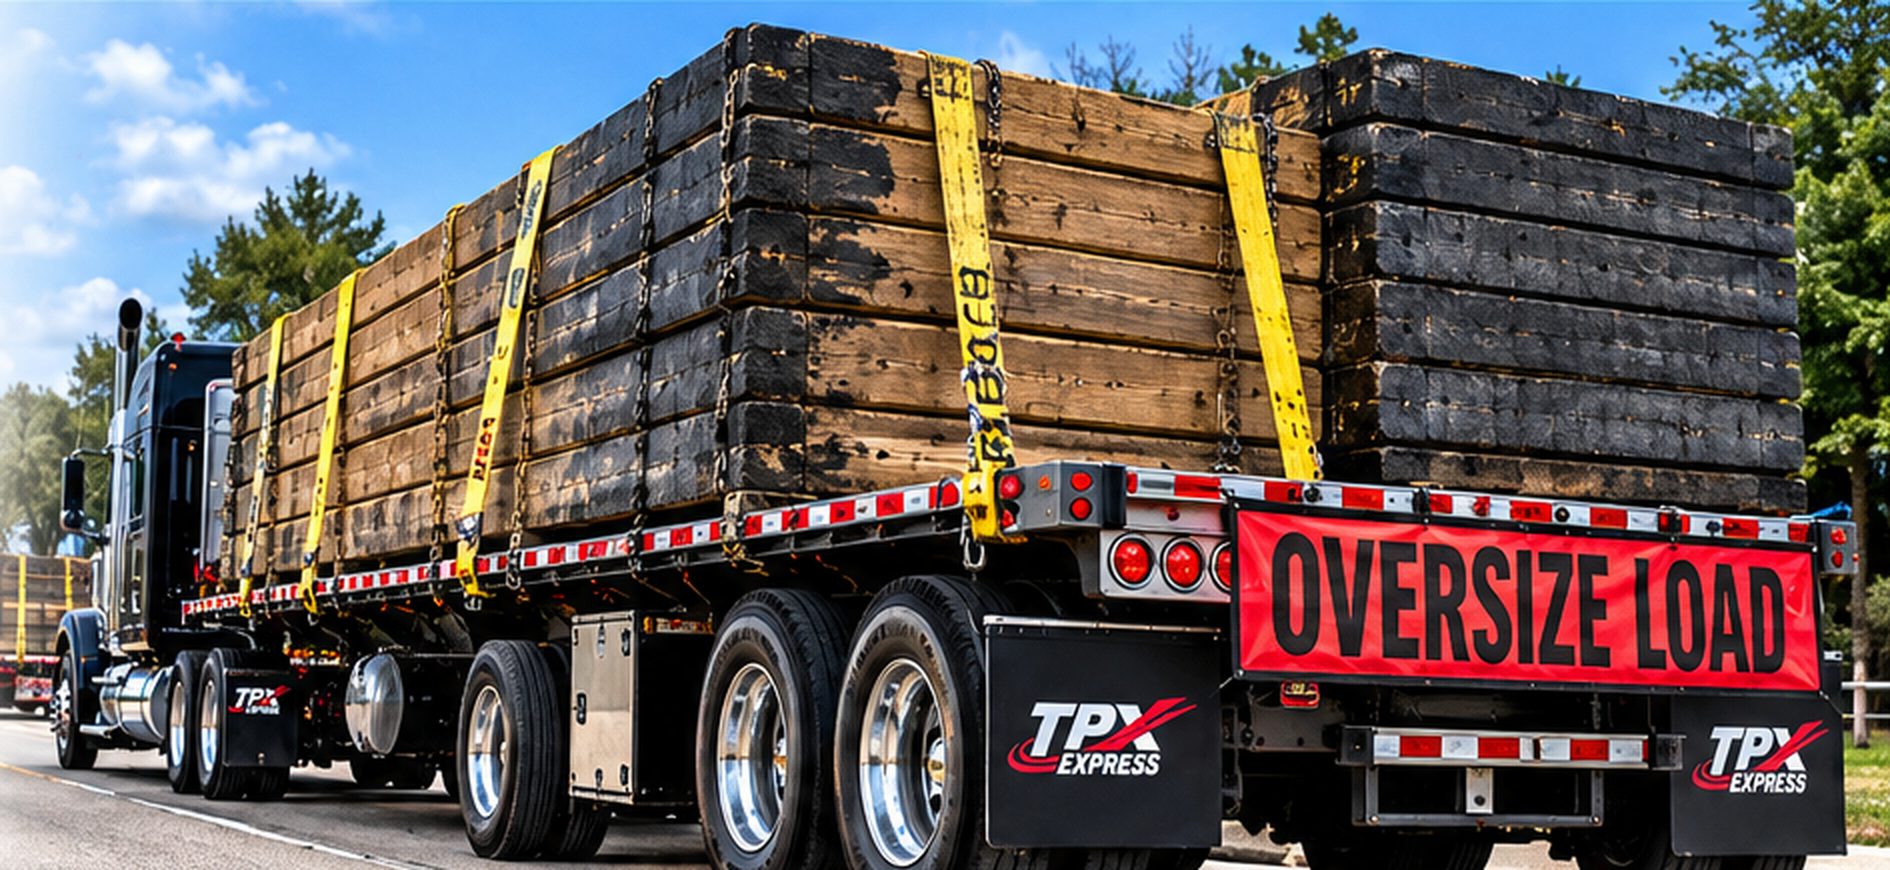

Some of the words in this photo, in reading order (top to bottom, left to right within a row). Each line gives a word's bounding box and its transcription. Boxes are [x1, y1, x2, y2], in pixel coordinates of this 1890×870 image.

[1271, 532, 1611, 668] OVERSIZE
[1634, 557, 1786, 674] LOAD
[235, 685, 287, 709] TPX
[1029, 697, 1186, 757] TPX
[1056, 752, 1161, 775] EXPRESS
[1709, 720, 1822, 776] TPX
[1729, 772, 1808, 794] EXPRESS
